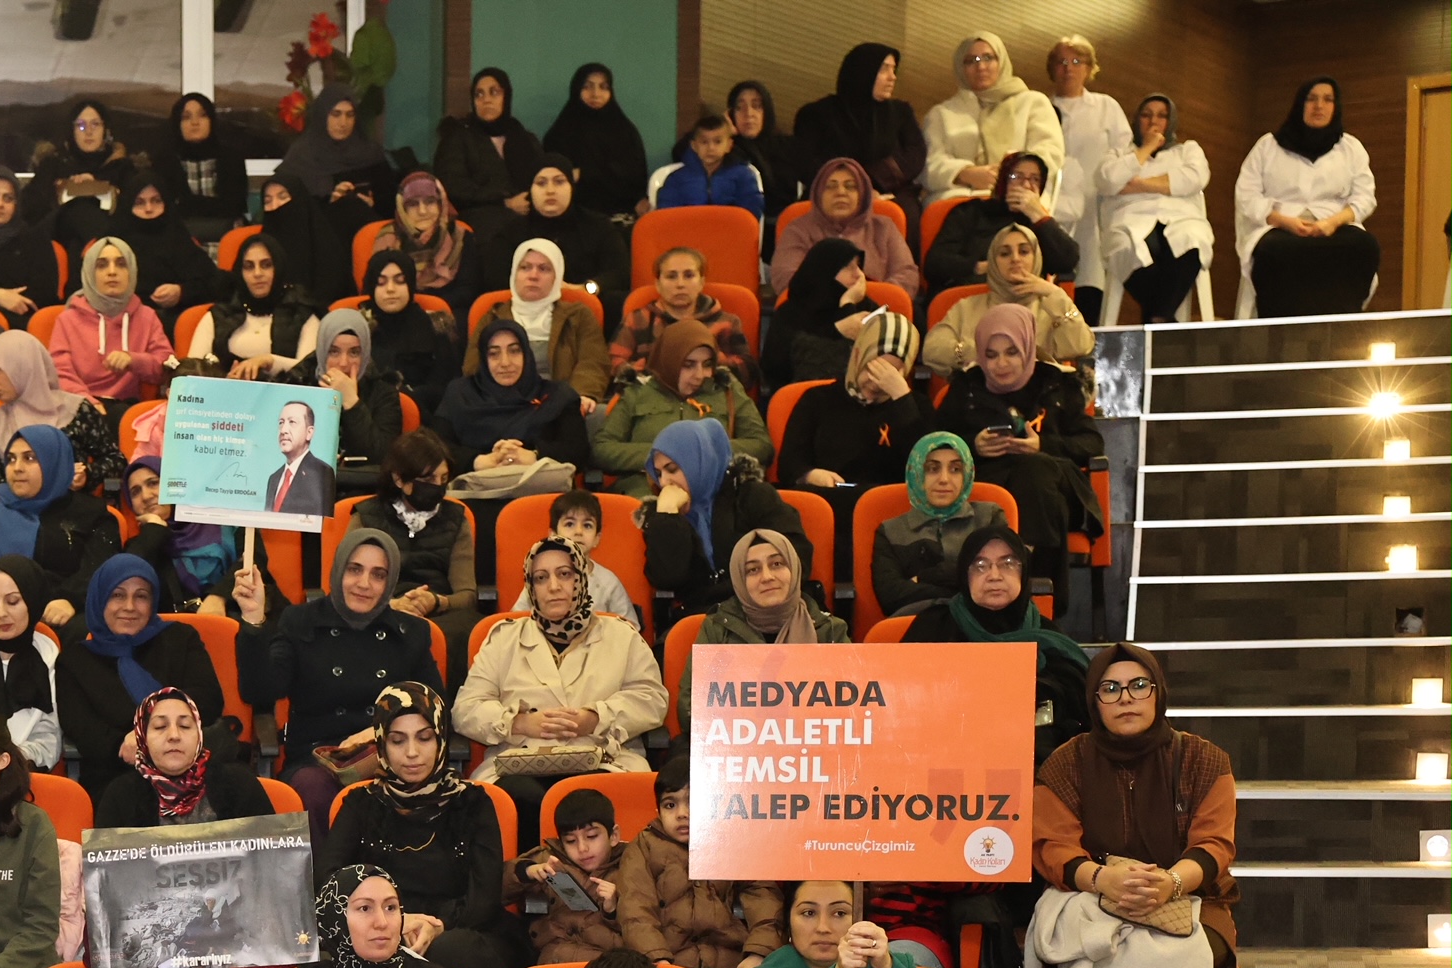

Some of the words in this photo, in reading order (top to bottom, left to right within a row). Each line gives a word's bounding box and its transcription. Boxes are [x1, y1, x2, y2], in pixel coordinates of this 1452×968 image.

[177, 394, 205, 404] Kadına
[211, 421, 244, 432] şiddeti
[173, 431, 195, 440] insan
[194, 445, 217, 455] kabul
[219, 448, 247, 457] etmez.
[708, 681, 886, 707] MEDYADA
[705, 709, 873, 745] ADALETLİ
[706, 748, 829, 783] TEMSİL
[823, 786, 1020, 822] EDİYORUZ.
[87, 847, 147, 863] GAZZE'DE
[150, 838, 227, 859] ÖLDÜRÜLEN
[230, 835, 305, 852] KADINLARA
[804, 837, 915, 854] #TuruncuÇizgimiz
[170, 953, 232, 968] #kararlıyız
